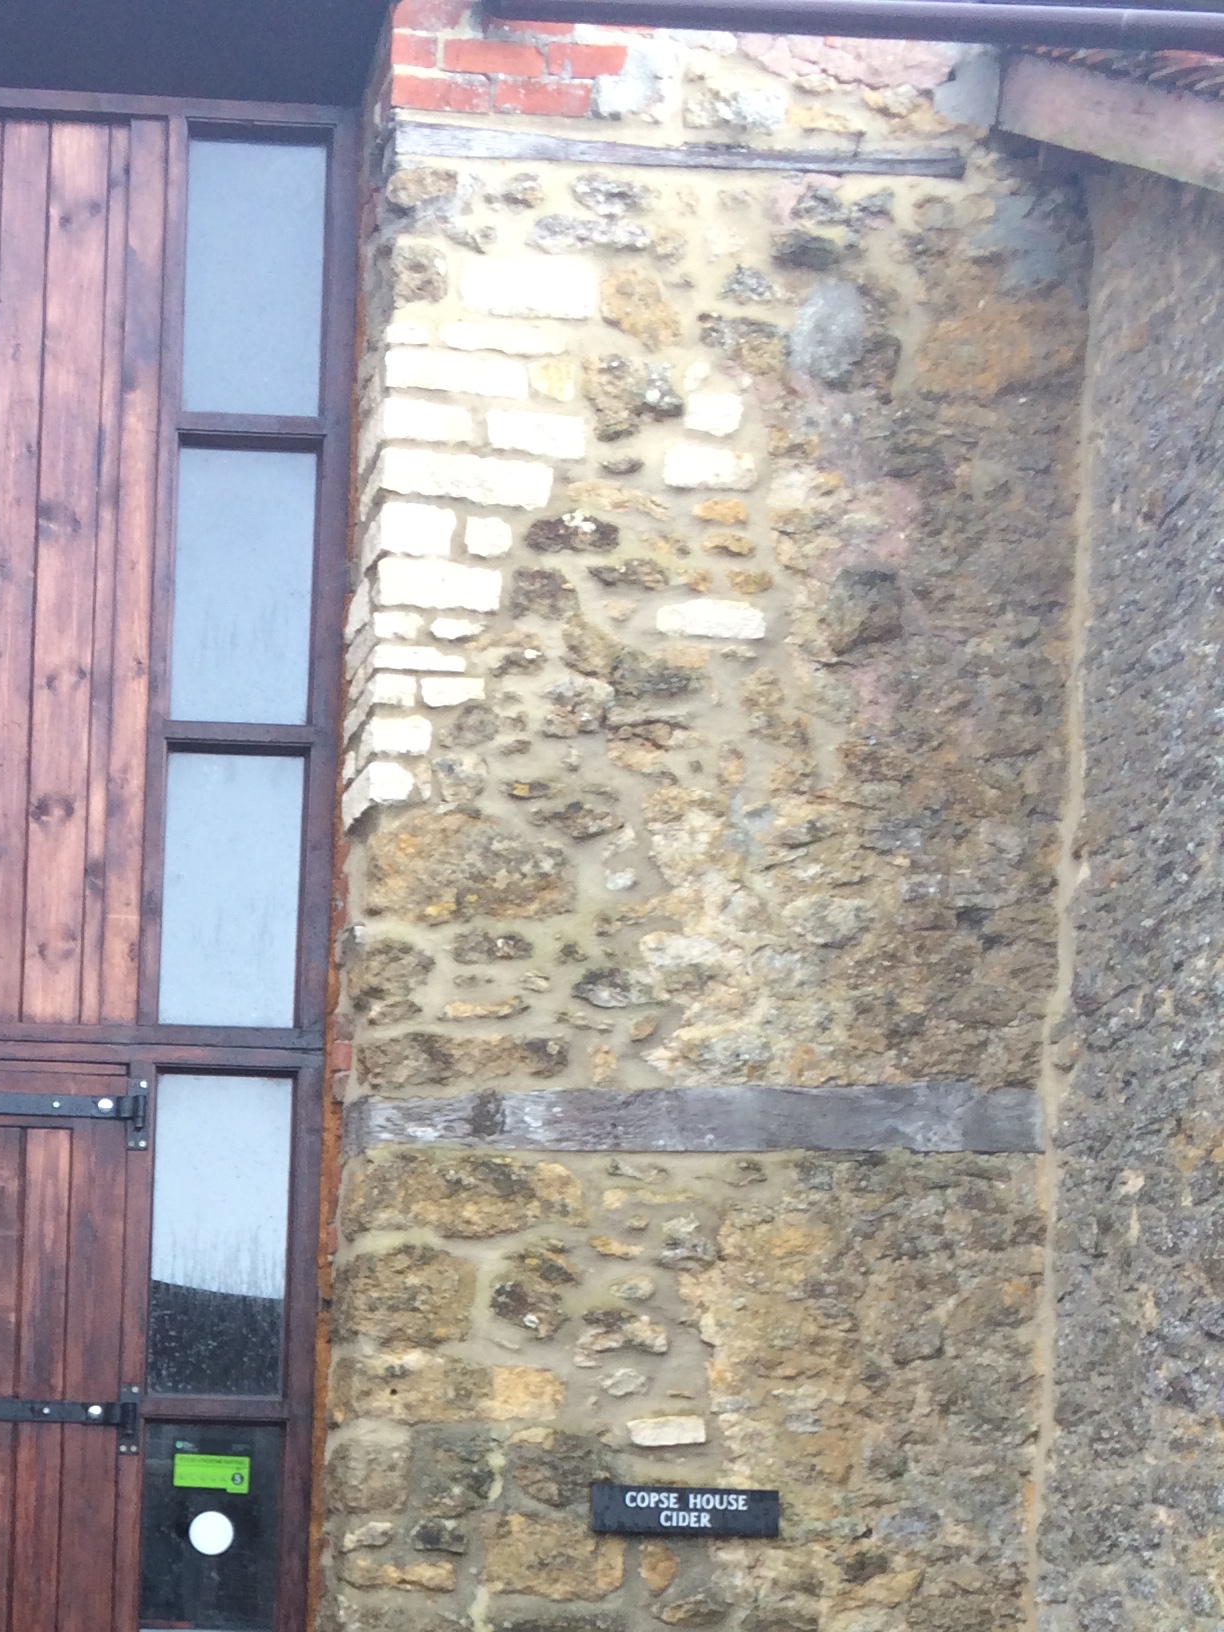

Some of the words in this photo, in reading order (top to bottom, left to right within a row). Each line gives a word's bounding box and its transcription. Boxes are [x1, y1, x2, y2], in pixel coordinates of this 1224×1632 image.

[625, 1491, 679, 1508] COPSE
[688, 1493, 748, 1511] HOUSE
[659, 1510, 712, 1527] CIDER
